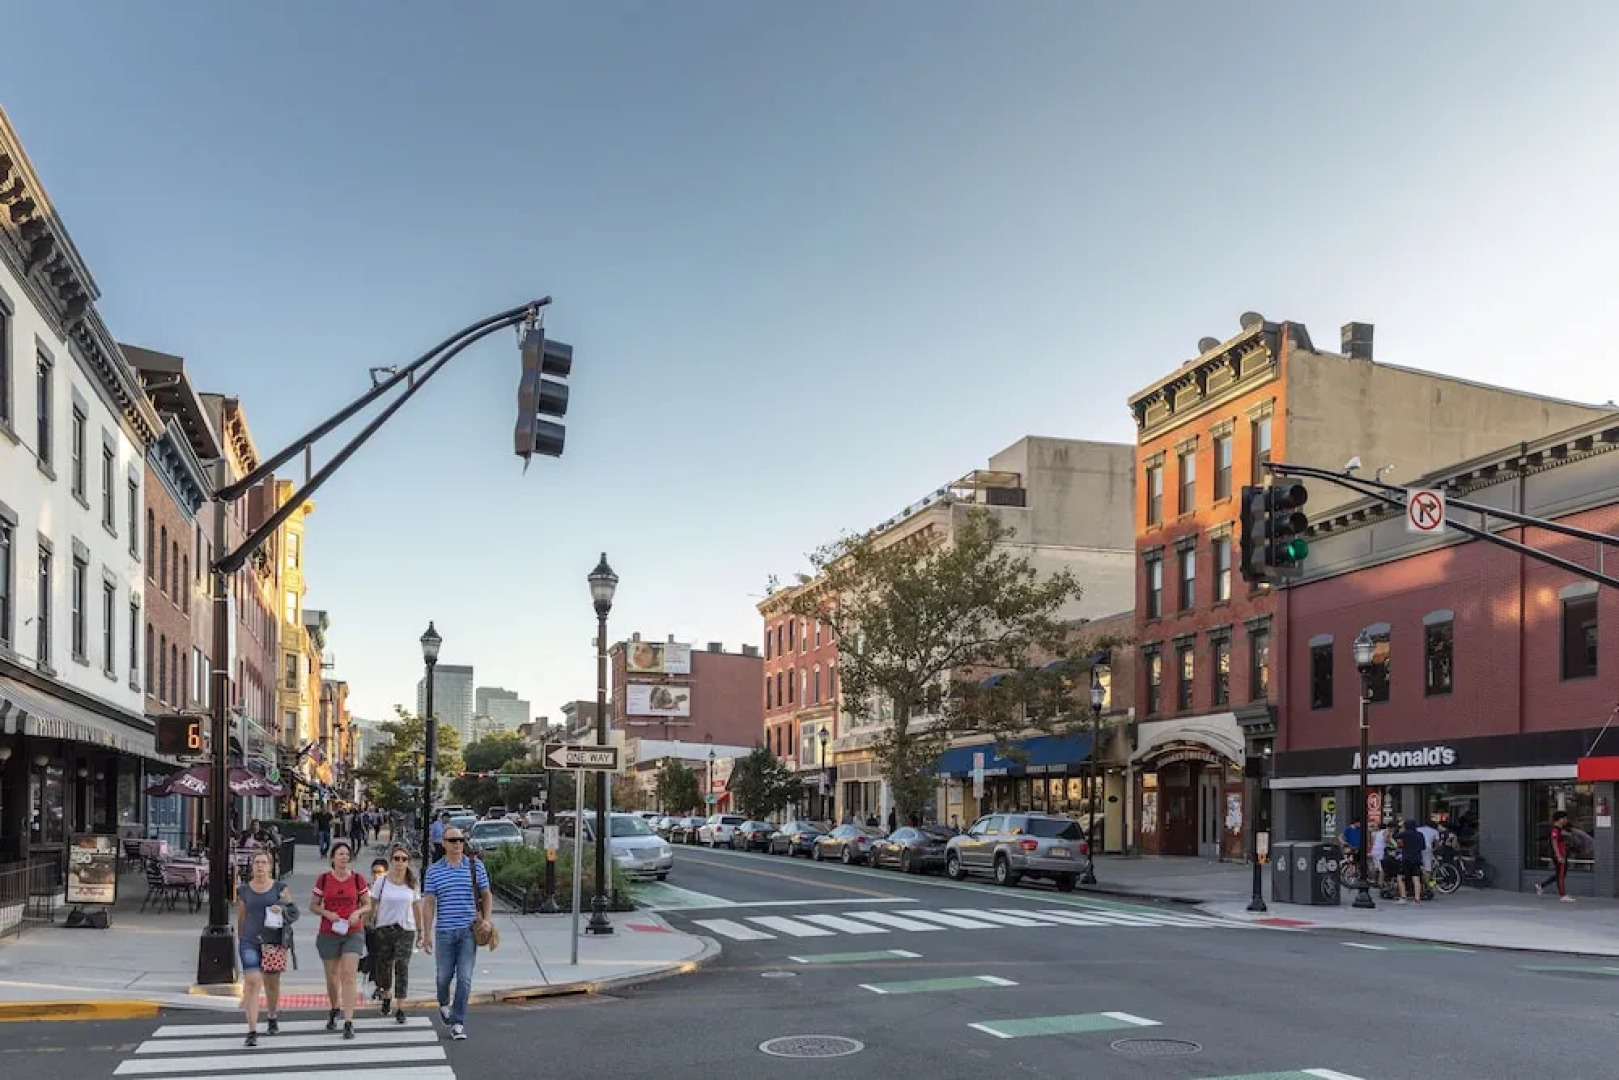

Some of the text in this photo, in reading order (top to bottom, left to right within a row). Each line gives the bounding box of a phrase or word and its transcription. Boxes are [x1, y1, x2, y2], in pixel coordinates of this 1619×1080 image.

[188, 723, 200, 749] 6
[567, 752, 610, 762] ONE WAY
[1352, 746, 1455, 769] McDonald's
